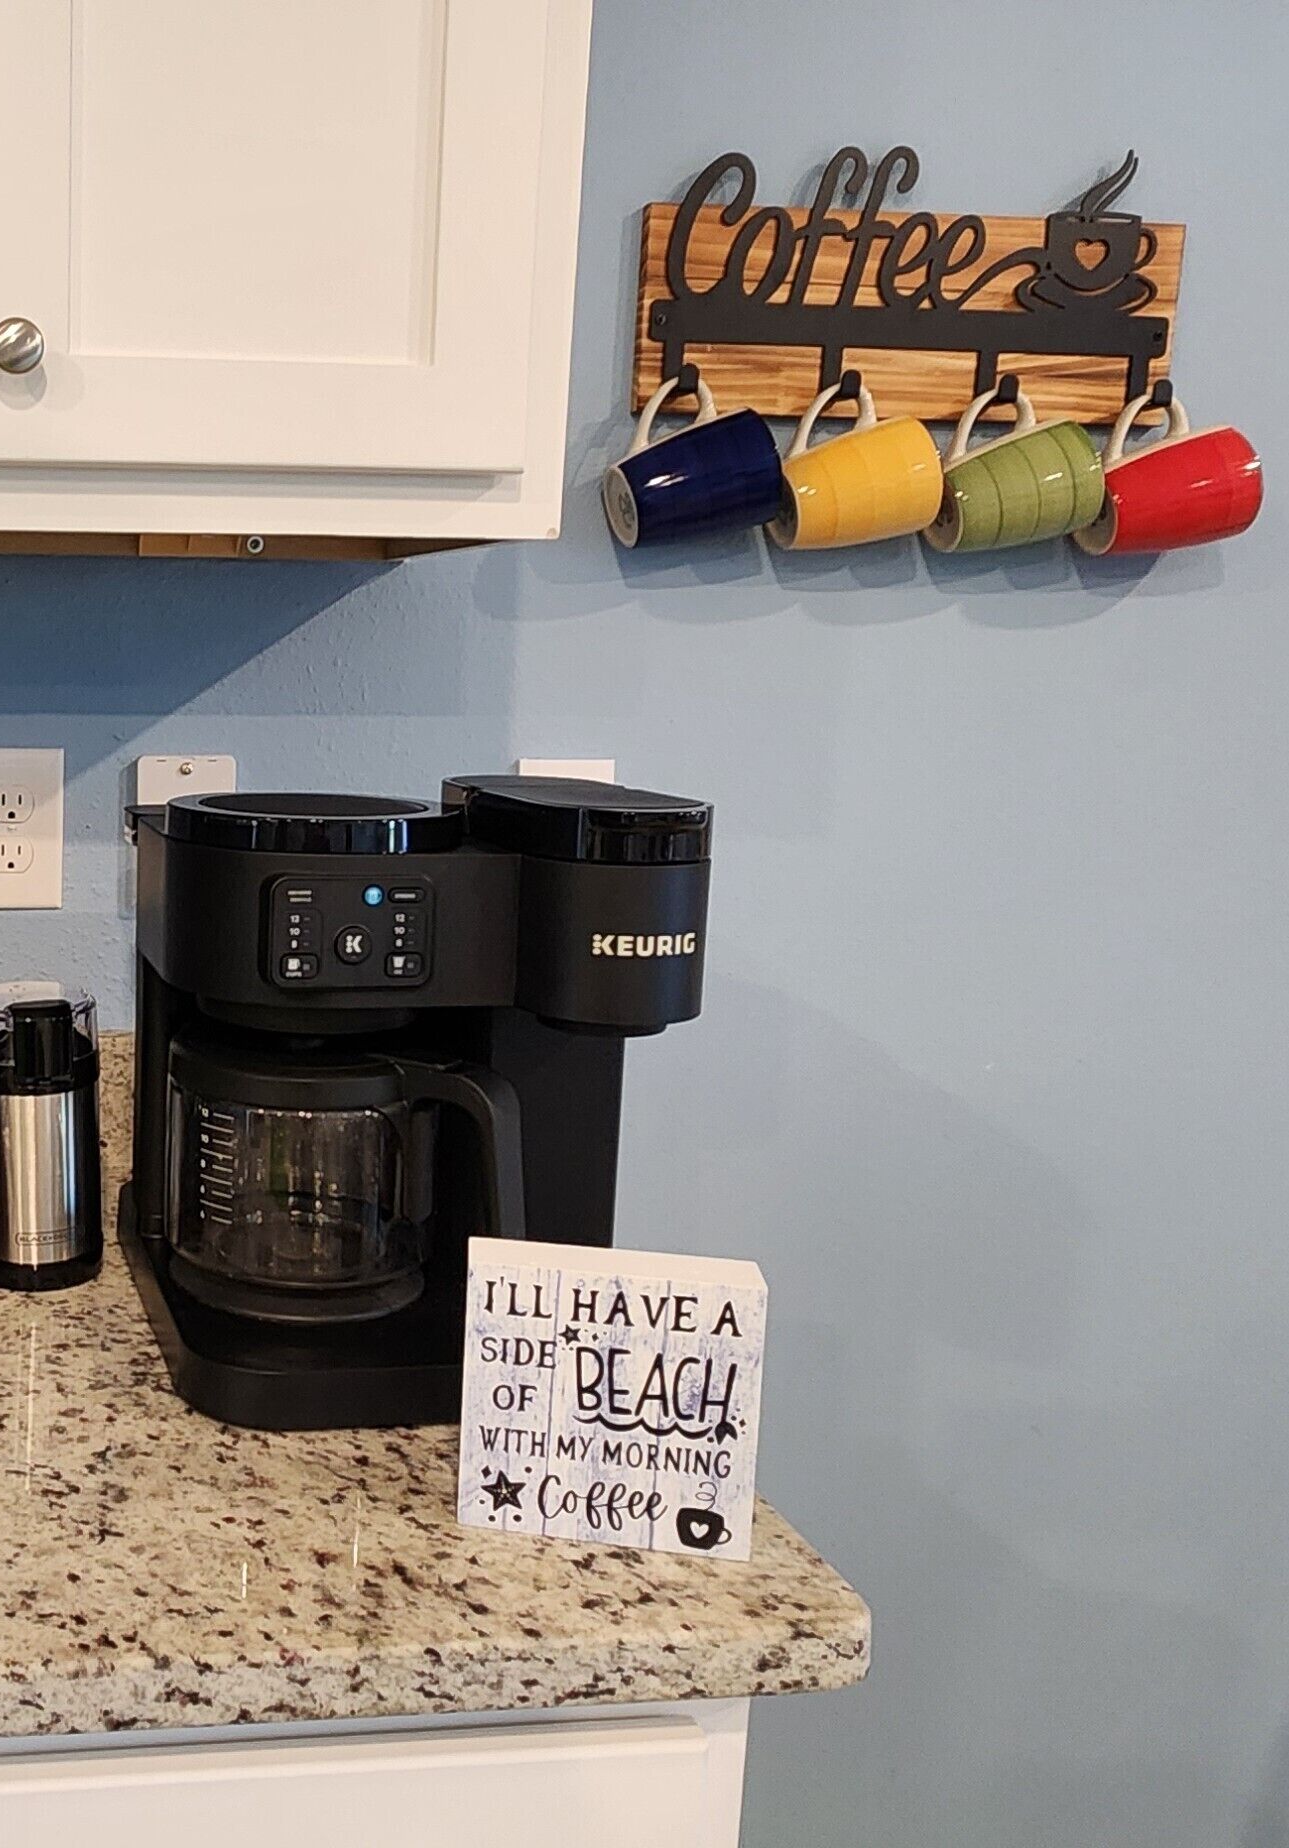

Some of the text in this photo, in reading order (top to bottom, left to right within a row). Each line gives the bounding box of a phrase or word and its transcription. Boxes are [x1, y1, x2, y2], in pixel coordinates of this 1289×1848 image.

[666, 146, 988, 309] Coffee
[592, 931, 696, 957] KEURIG
[484, 1276, 743, 1337] I'LL HAVE A
[480, 1337, 557, 1369] SIDE
[492, 1384, 538, 1412] OF
[575, 1346, 737, 1423] BEACH
[479, 1425, 731, 1479] WITH MY MORNING
[537, 1474, 668, 1532] Coffee
